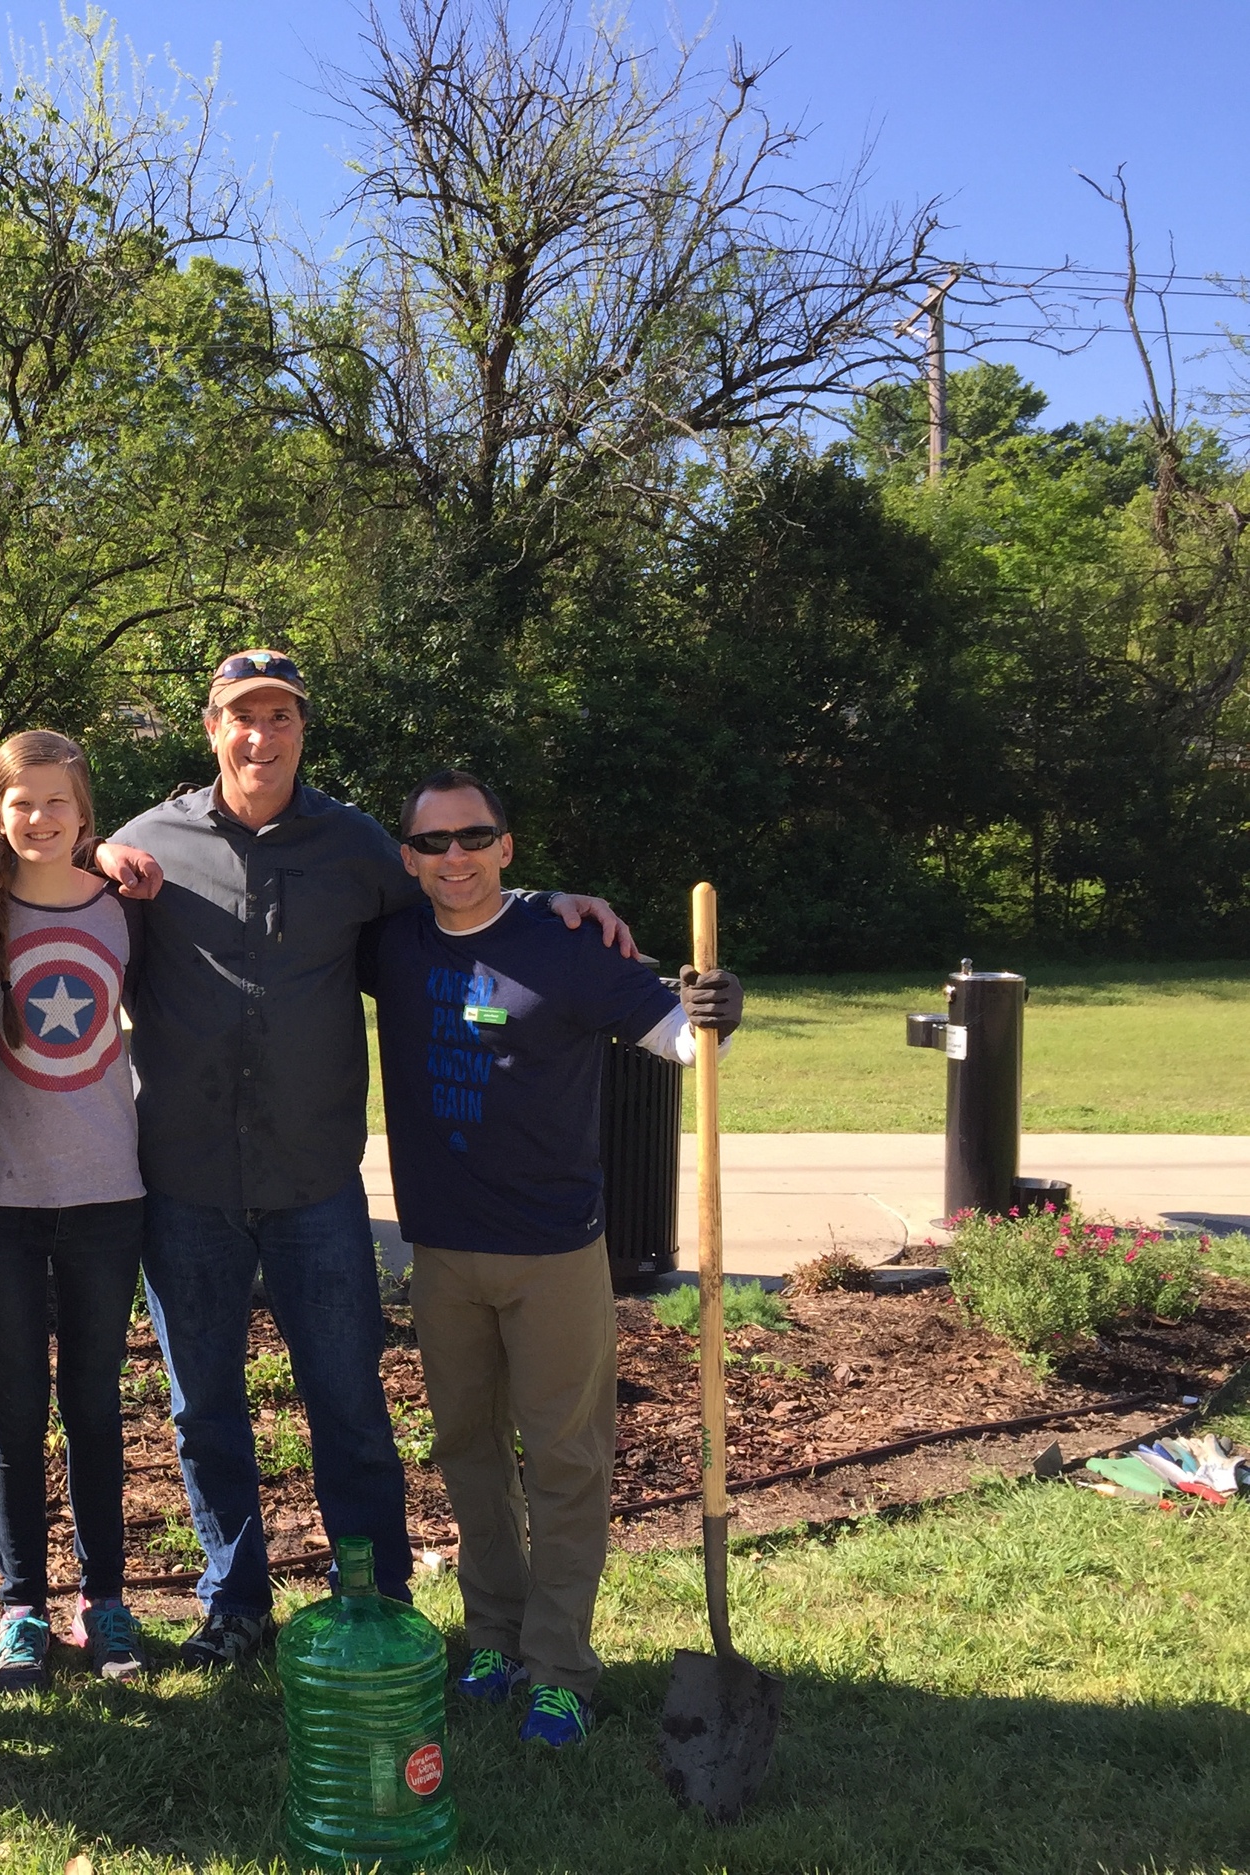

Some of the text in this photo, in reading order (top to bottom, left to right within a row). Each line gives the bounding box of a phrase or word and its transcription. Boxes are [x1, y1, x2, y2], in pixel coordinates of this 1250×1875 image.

[427, 967, 494, 1006] KNOW
[432, 1007, 480, 1044] PAIN
[427, 1044, 494, 1085] KNOW
[433, 1084, 481, 1122] GAIN
[409, 1770, 441, 1786] Mountain
